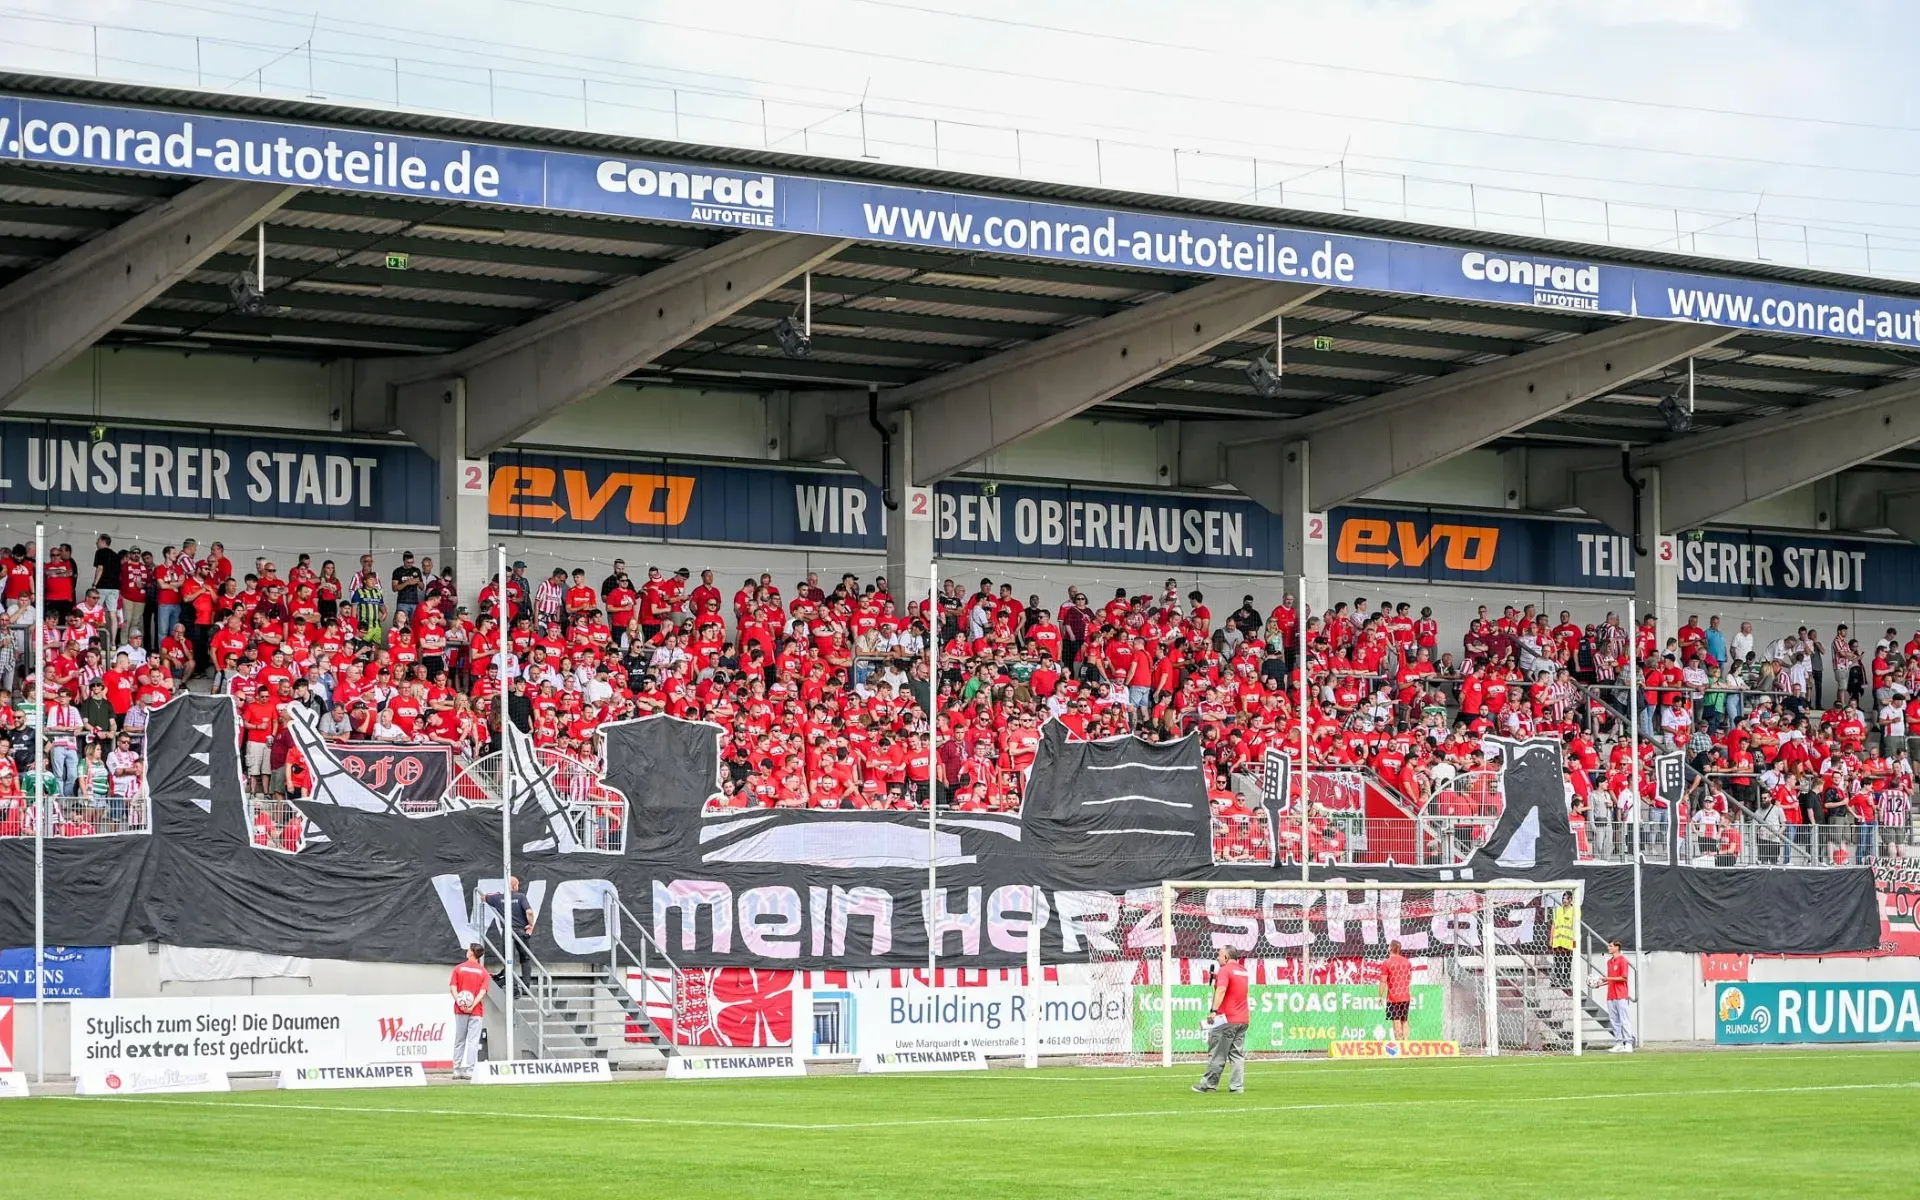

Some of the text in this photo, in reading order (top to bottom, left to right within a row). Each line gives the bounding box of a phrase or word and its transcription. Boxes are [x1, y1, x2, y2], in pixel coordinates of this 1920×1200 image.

[597, 161, 774, 207] Conrad
[691, 208, 774, 227] AUTOTEILE
[863, 202, 1354, 282] www.conrad-autoteile.de
[1461, 252, 1599, 293] Conrad
[28, 437, 230, 500] UNSERER
[246, 451, 378, 507] STADT
[464, 466, 482, 490] 2
[912, 493, 927, 515] 2
[795, 484, 867, 535] WIR
[1015, 497, 1253, 558] OBERHAUSEN.
[1309, 518, 1323, 539] 2
[1336, 518, 1499, 571] evo
[1660, 541, 1672, 560] 3
[1577, 534, 1635, 577] TEIL
[1783, 546, 1866, 591] STADT
[1888, 798, 1902, 812] 12
[24, 969, 64, 984] ENS
[891, 992, 1125, 1029] Building Rmodel
[1261, 991, 1337, 1013] STOAG
[1778, 988, 1920, 1034] RUNDA
[86, 1013, 340, 1039] Stylisch zum Sieg! Die Daumen
[377, 1016, 446, 1042] Westfield
[1289, 1026, 1336, 1040] STOAG
[1341, 1026, 1366, 1040] App
[1725, 1024, 1759, 1034] RUNDAS
[86, 1034, 309, 1060] sind extra fest gedrückt.
[396, 1044, 427, 1056] CENTRO
[896, 1039, 914, 1048] Uwe
[916, 1038, 960, 1049] Marquardt
[1336, 1041, 1455, 1057] WEST LOTTO
